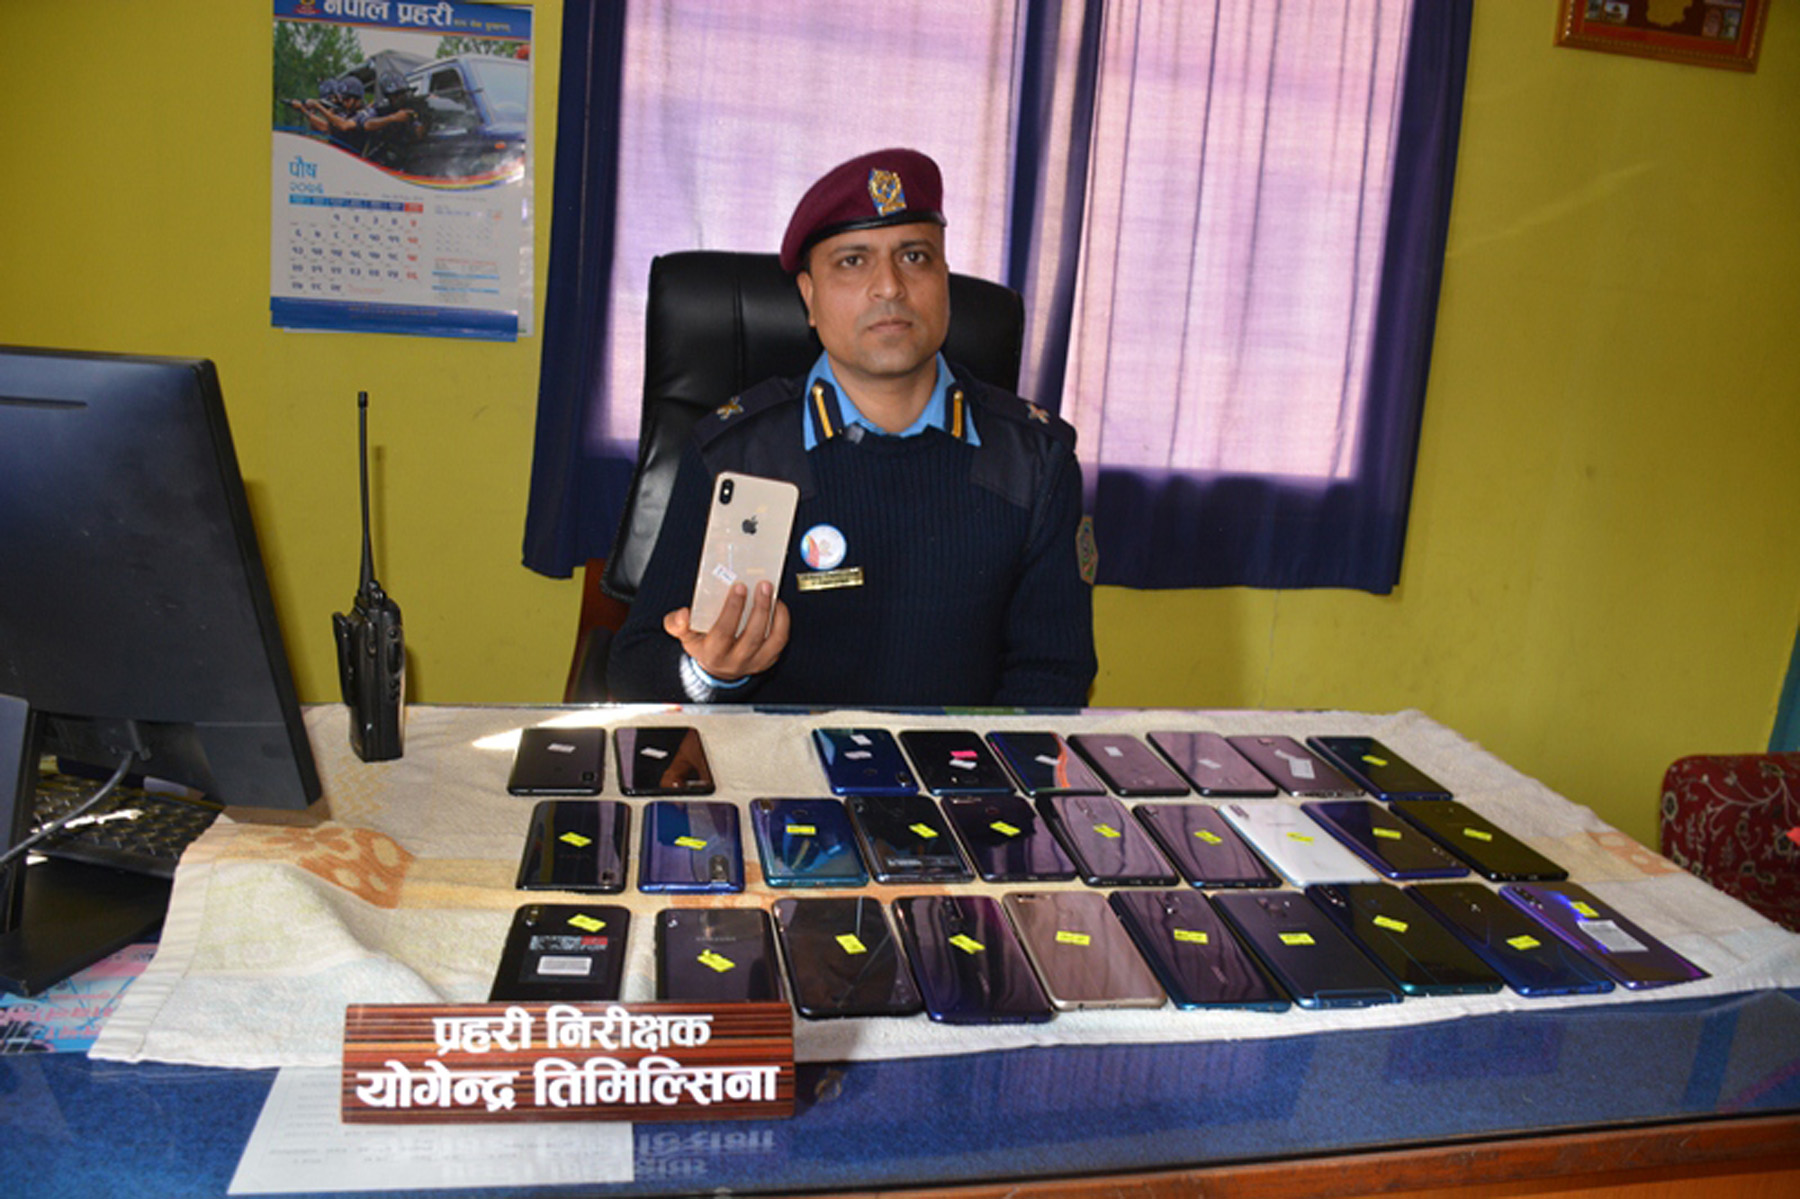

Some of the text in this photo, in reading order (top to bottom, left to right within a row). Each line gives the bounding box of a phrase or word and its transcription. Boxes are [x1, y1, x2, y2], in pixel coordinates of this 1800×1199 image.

[323, 0, 390, 20] नपाल
[397, 2, 455, 27] प्रहरी
[288, 155, 318, 178] पौष
[432, 1005, 714, 1056] प्रहरी निरीक्षक
[356, 1059, 517, 1112] योगेन्द्र
[533, 1055, 781, 1108] तिमिल्सिना
